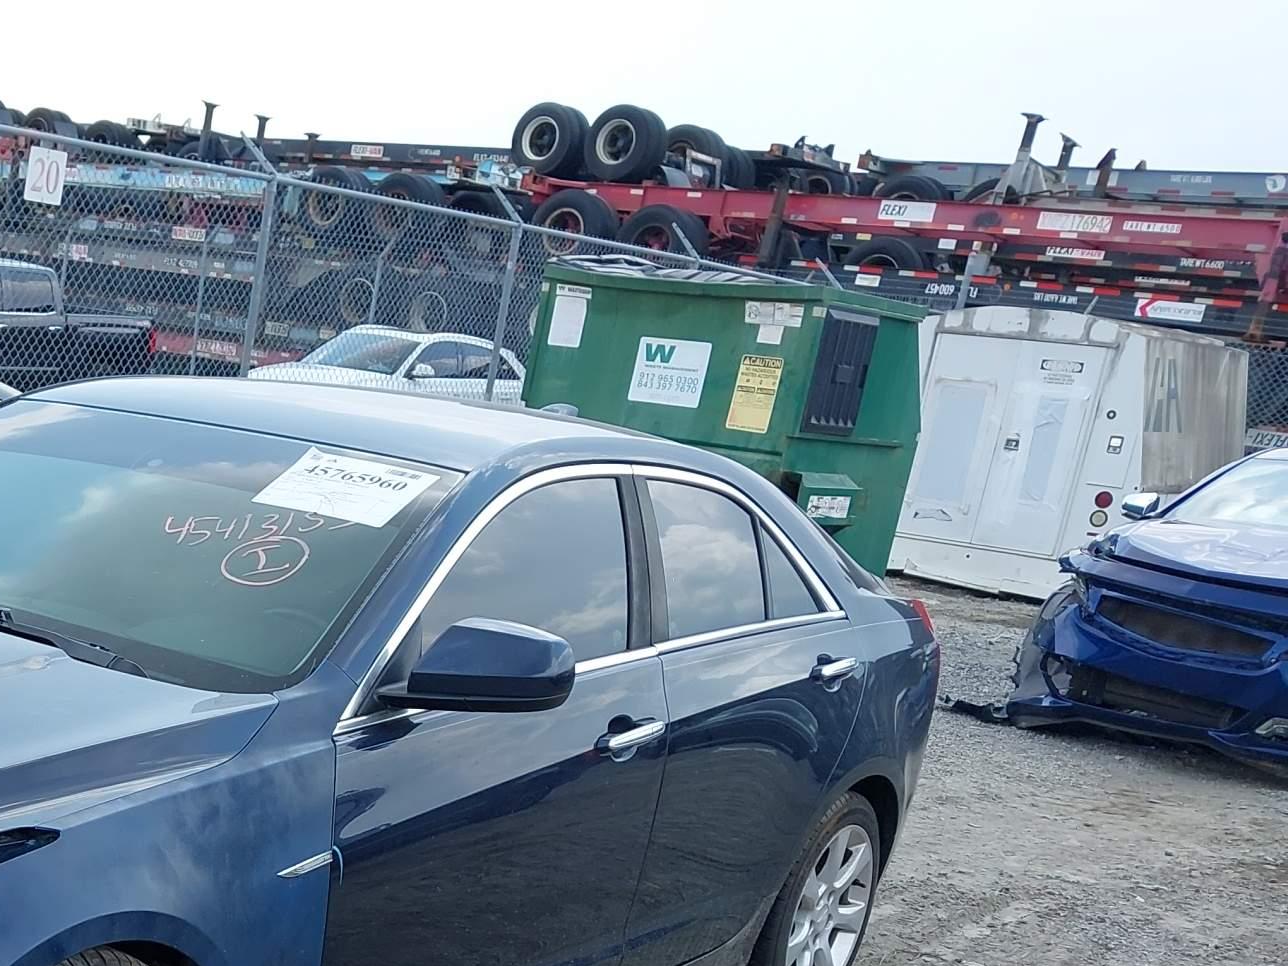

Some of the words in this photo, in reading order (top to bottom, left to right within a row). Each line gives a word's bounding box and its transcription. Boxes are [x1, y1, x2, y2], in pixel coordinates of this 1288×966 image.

[30, 157, 61, 194] 20
[880, 203, 908, 216] FLEXI
[645, 343, 676, 364] W
[750, 357, 782, 368] CAUTION
[676, 375, 700, 386] 0300
[304, 464, 408, 492] 45765960
